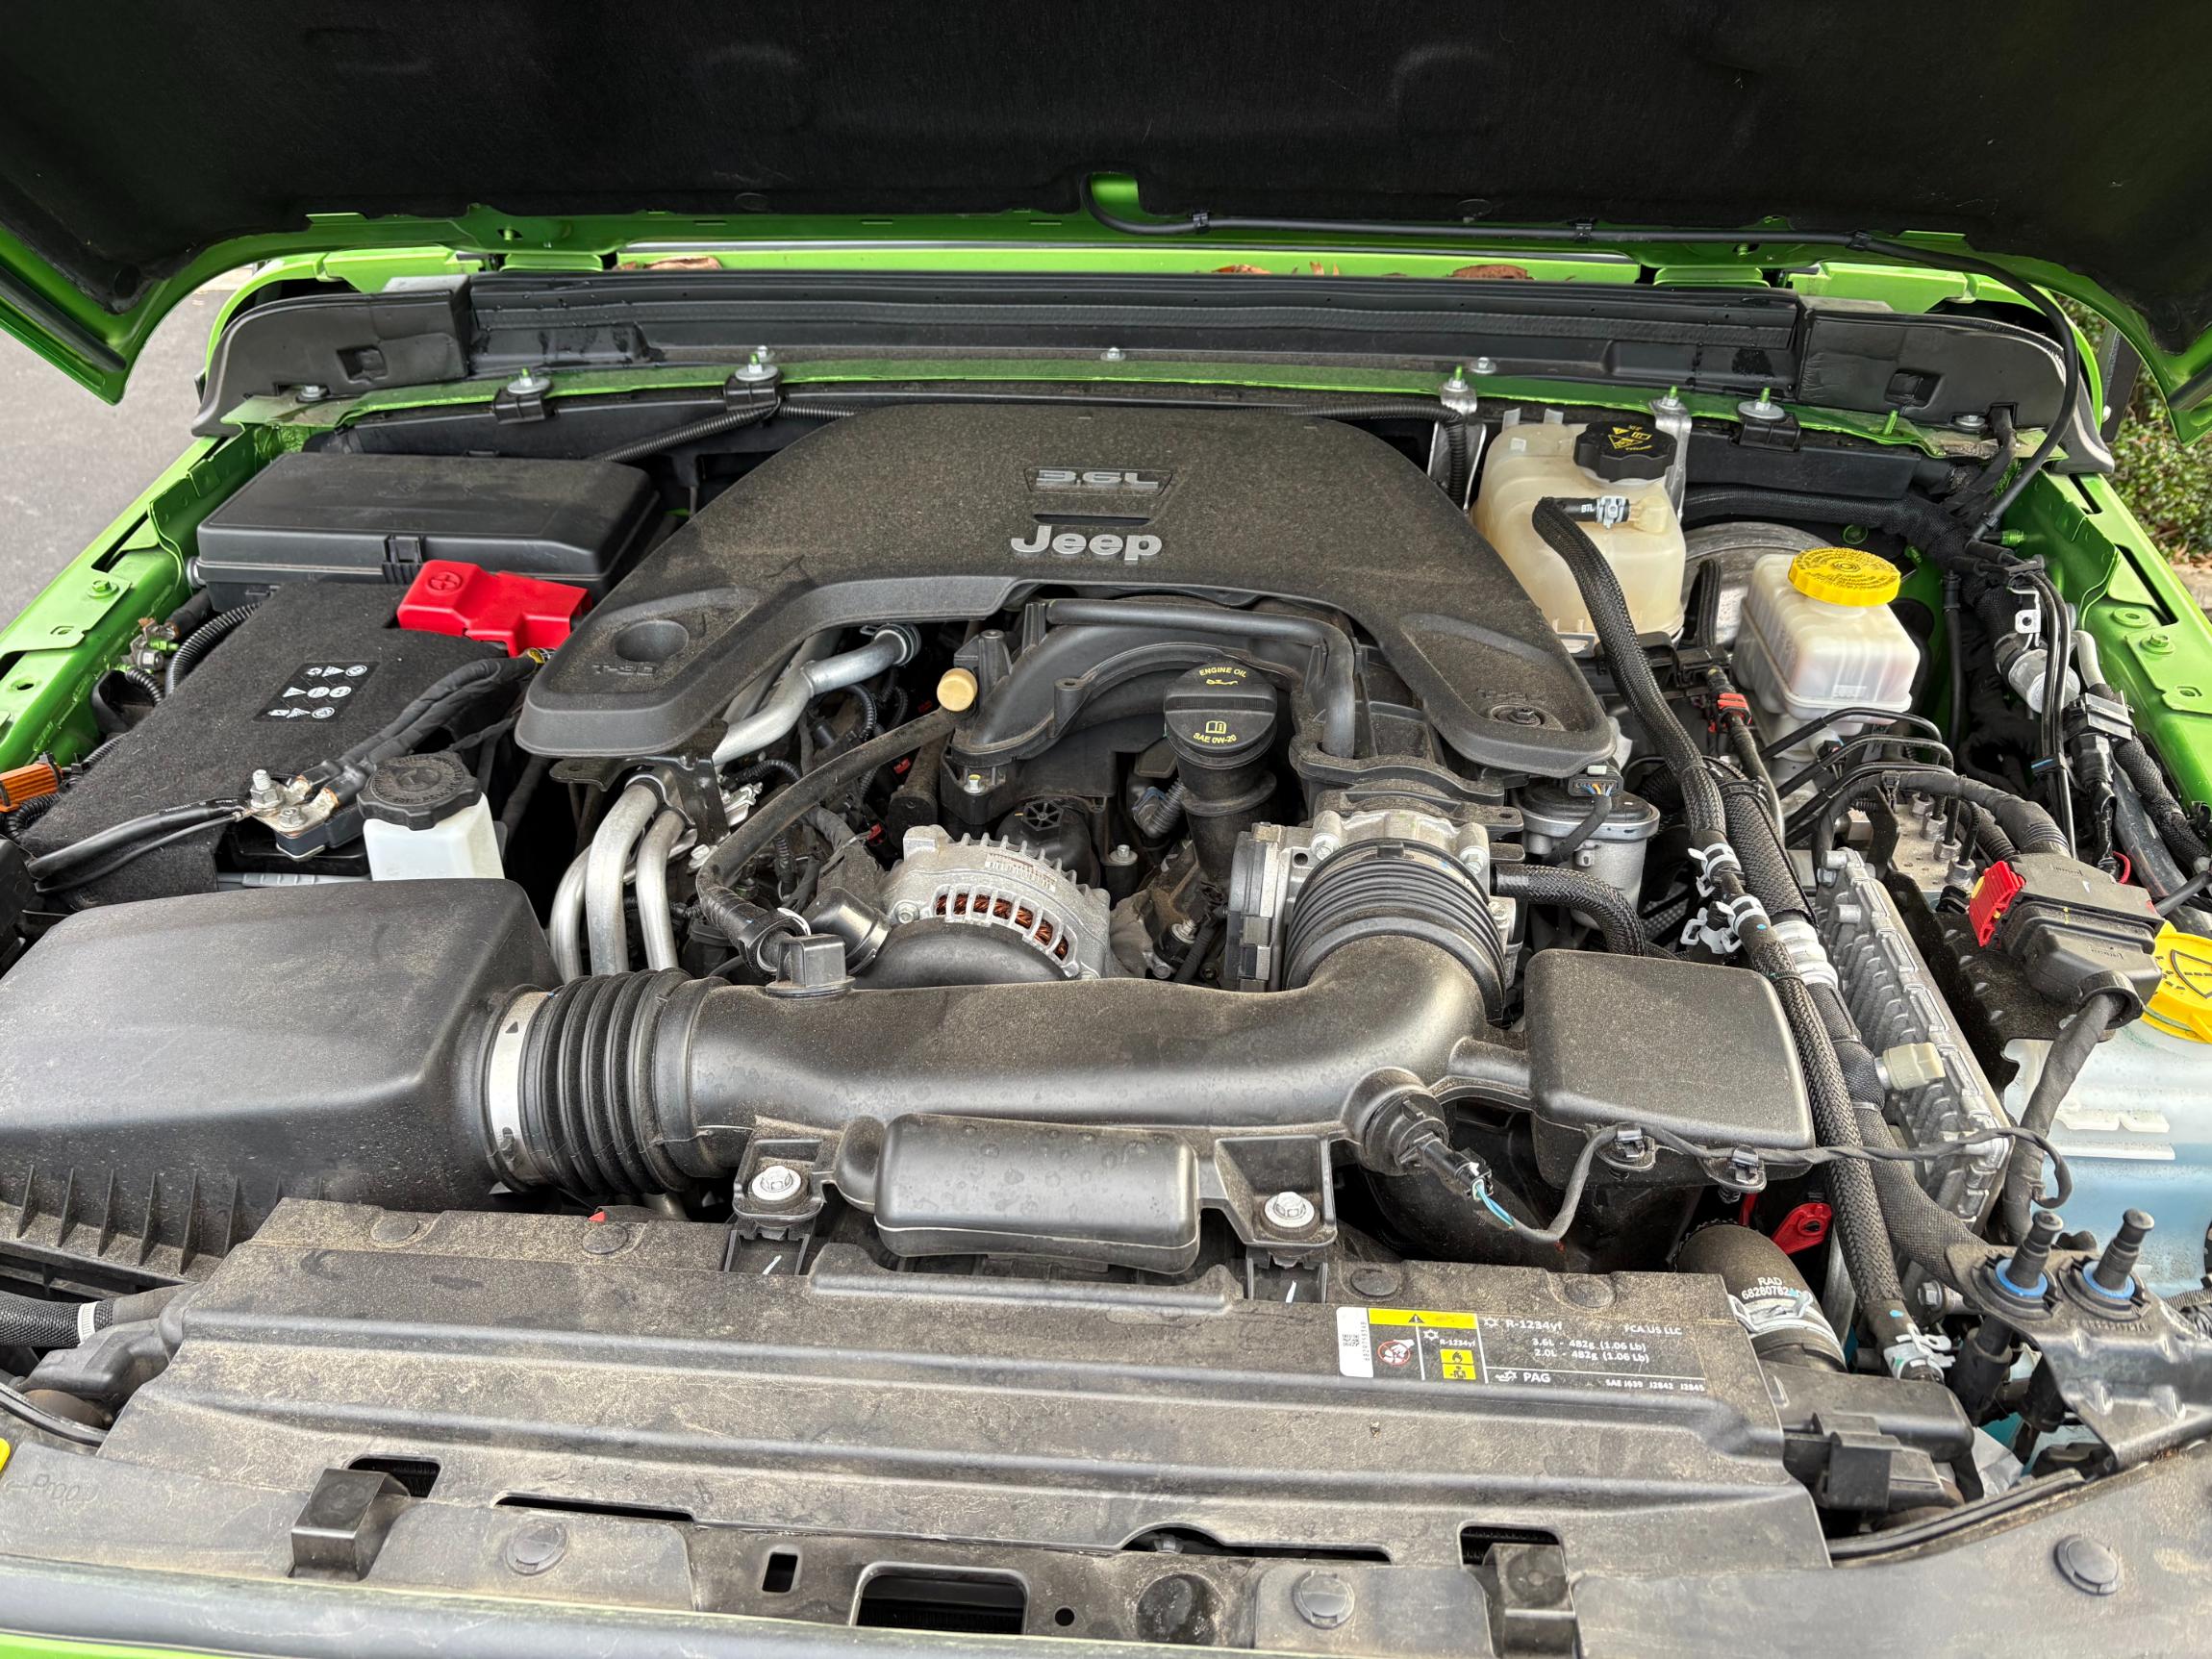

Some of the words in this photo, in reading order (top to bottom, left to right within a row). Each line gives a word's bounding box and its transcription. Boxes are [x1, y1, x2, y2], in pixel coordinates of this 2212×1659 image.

[1035, 469, 1159, 490] 3.6L
[1581, 504, 1596, 513] BTL
[1010, 525, 1163, 564] Jeep
[1198, 666, 1231, 676] ENGINE
[1234, 667, 1247, 678] OIL
[1193, 732, 1210, 742] SAE
[1212, 734, 1237, 744] 0W-20
[1757, 1276, 1783, 1286] RAD
[1506, 1320, 1563, 1332] R-1234yf
[1623, 1323, 1646, 1333] FCA
[1646, 1324, 1662, 1334] US
[1664, 1326, 1683, 1335] LLC
[1440, 1339, 1476, 1347] R-1234yf
[1532, 1337, 1555, 1346] 3.6L
[1569, 1339, 1596, 1350] 482g
[1600, 1340, 1627, 1351] (1.06
[1629, 1342, 1646, 1352] Lb)
[1534, 1348, 1557, 1358] 2.0L
[1571, 1349, 1597, 1361] 482g
[1602, 1351, 1630, 1362] (1.06
[1632, 1353, 1650, 1364] Lb)
[1522, 1371, 1551, 1383] PAG
[1605, 1378, 1622, 1387] SAE
